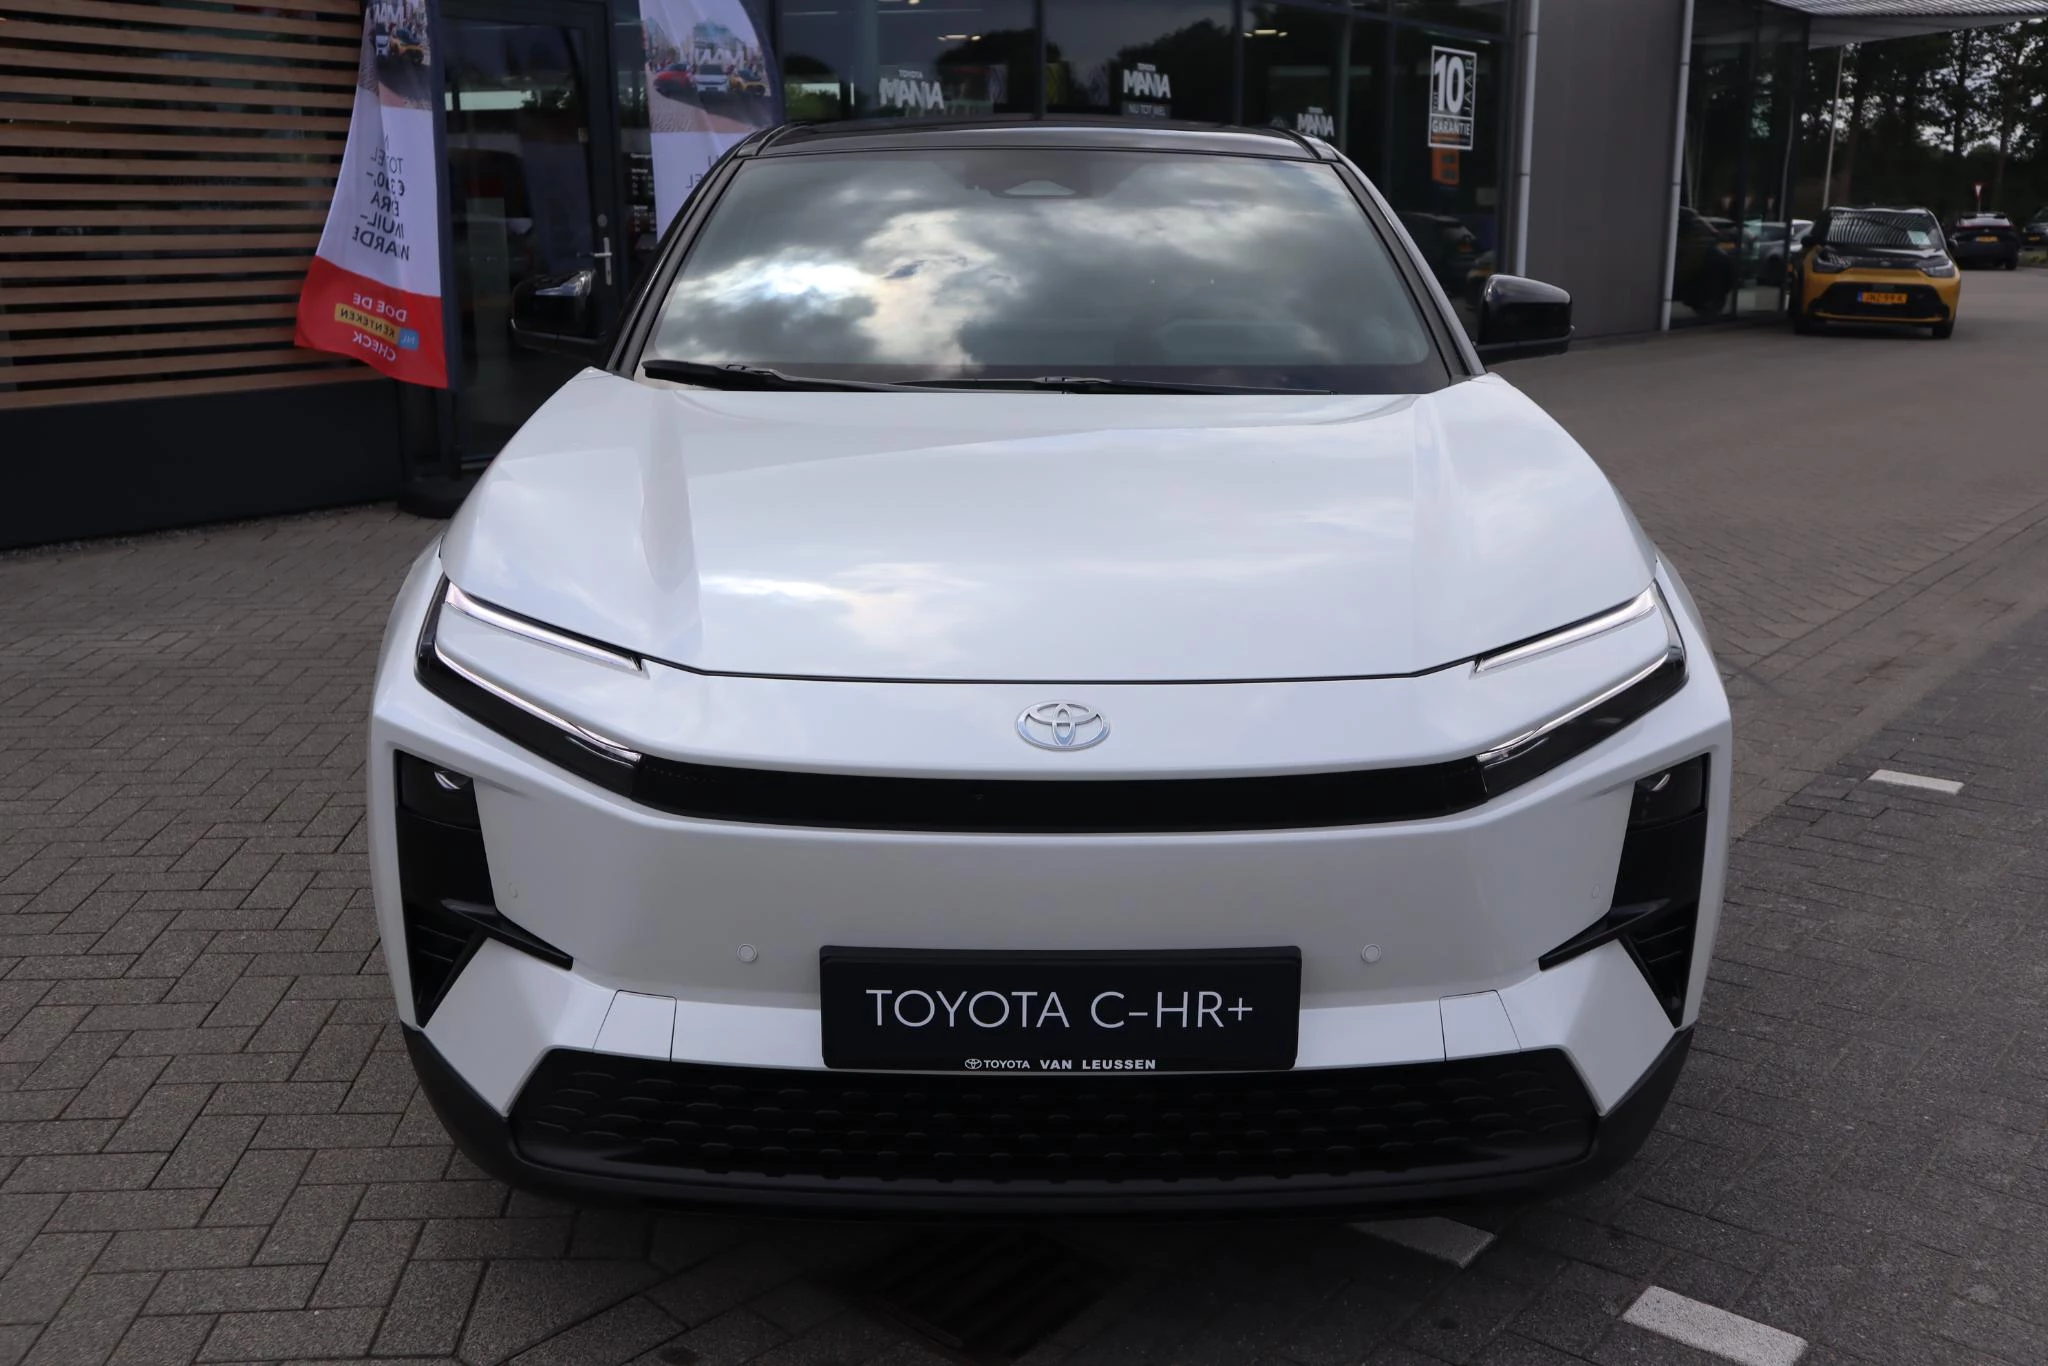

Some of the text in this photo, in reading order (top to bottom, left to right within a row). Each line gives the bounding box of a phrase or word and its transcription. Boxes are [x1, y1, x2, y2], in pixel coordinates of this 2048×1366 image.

[878, 76, 944, 110] MANIA
[1123, 69, 1171, 98] MANIA
[1434, 54, 1465, 114] 10
[1463, 59, 1473, 117] JAAR
[1298, 113, 1335, 137] MANIA
[1432, 119, 1471, 136] GARANTIE
[866, 989, 1253, 1029] TOYOTA C-HR+
[983, 1059, 1157, 1070] TOYOTA VAN LEUSSEN
